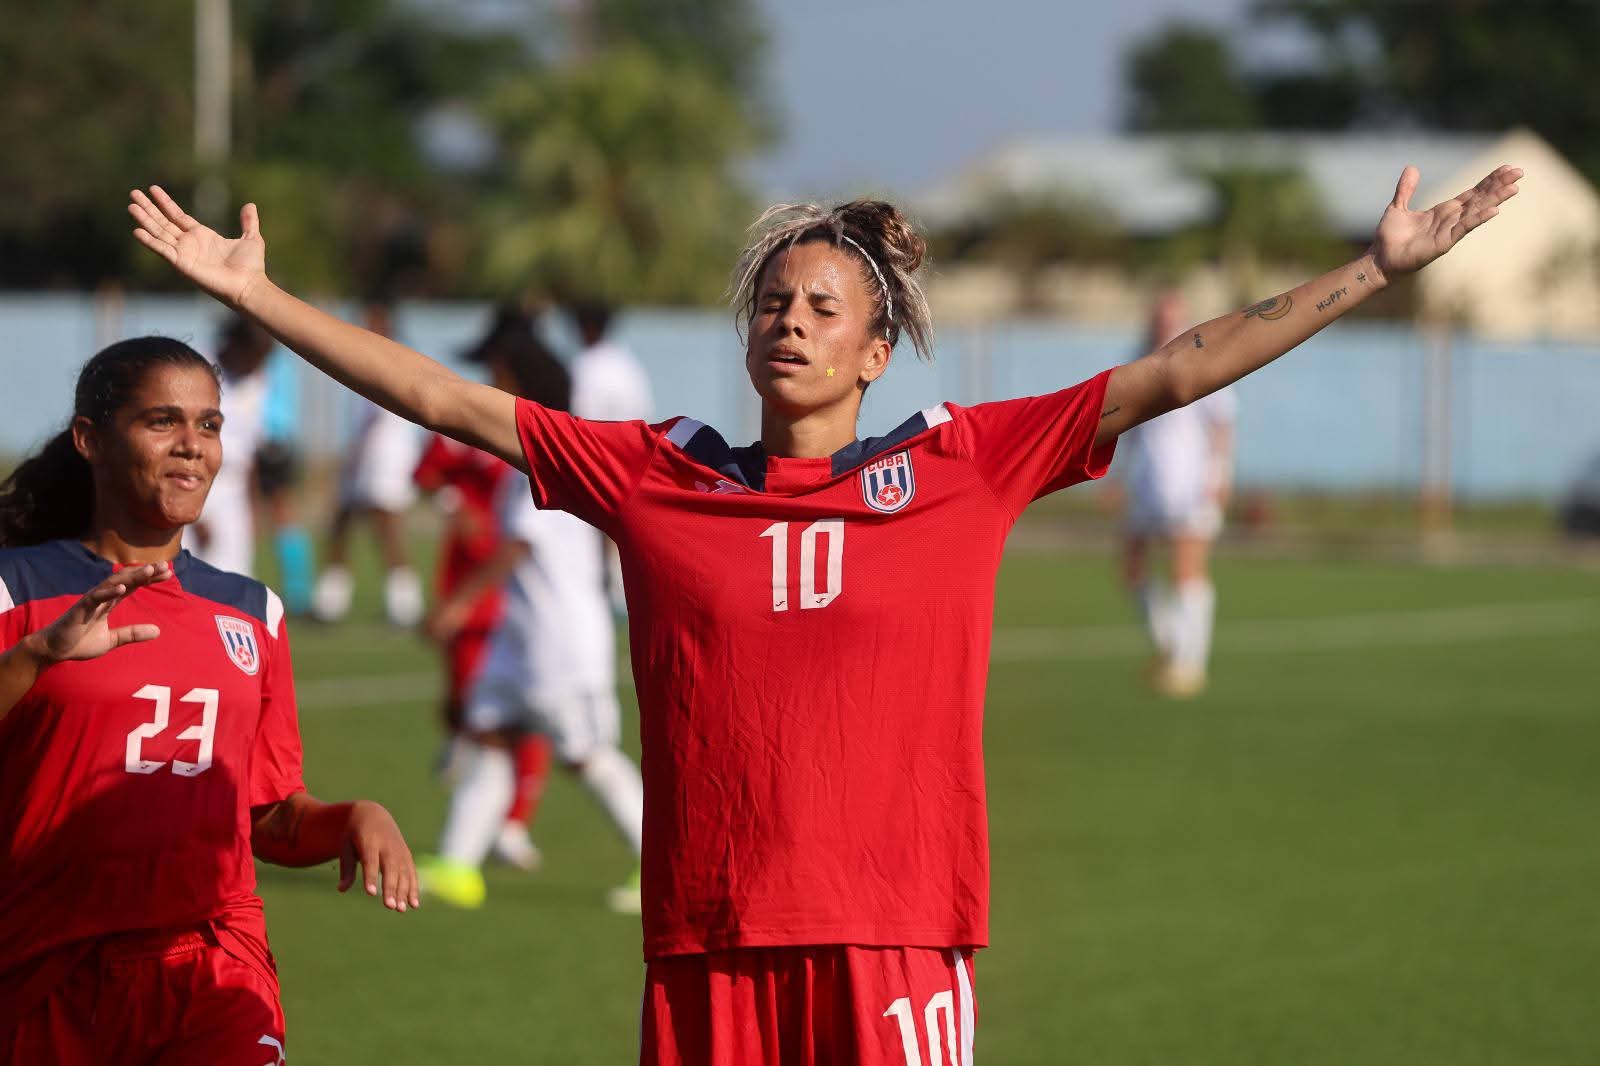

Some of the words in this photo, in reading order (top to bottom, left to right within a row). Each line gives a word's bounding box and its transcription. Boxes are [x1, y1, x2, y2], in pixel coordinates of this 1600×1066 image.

[867, 455, 904, 473] CUBA
[758, 518, 845, 612] 10
[125, 684, 220, 778] 23
[882, 989, 959, 1066] 10
